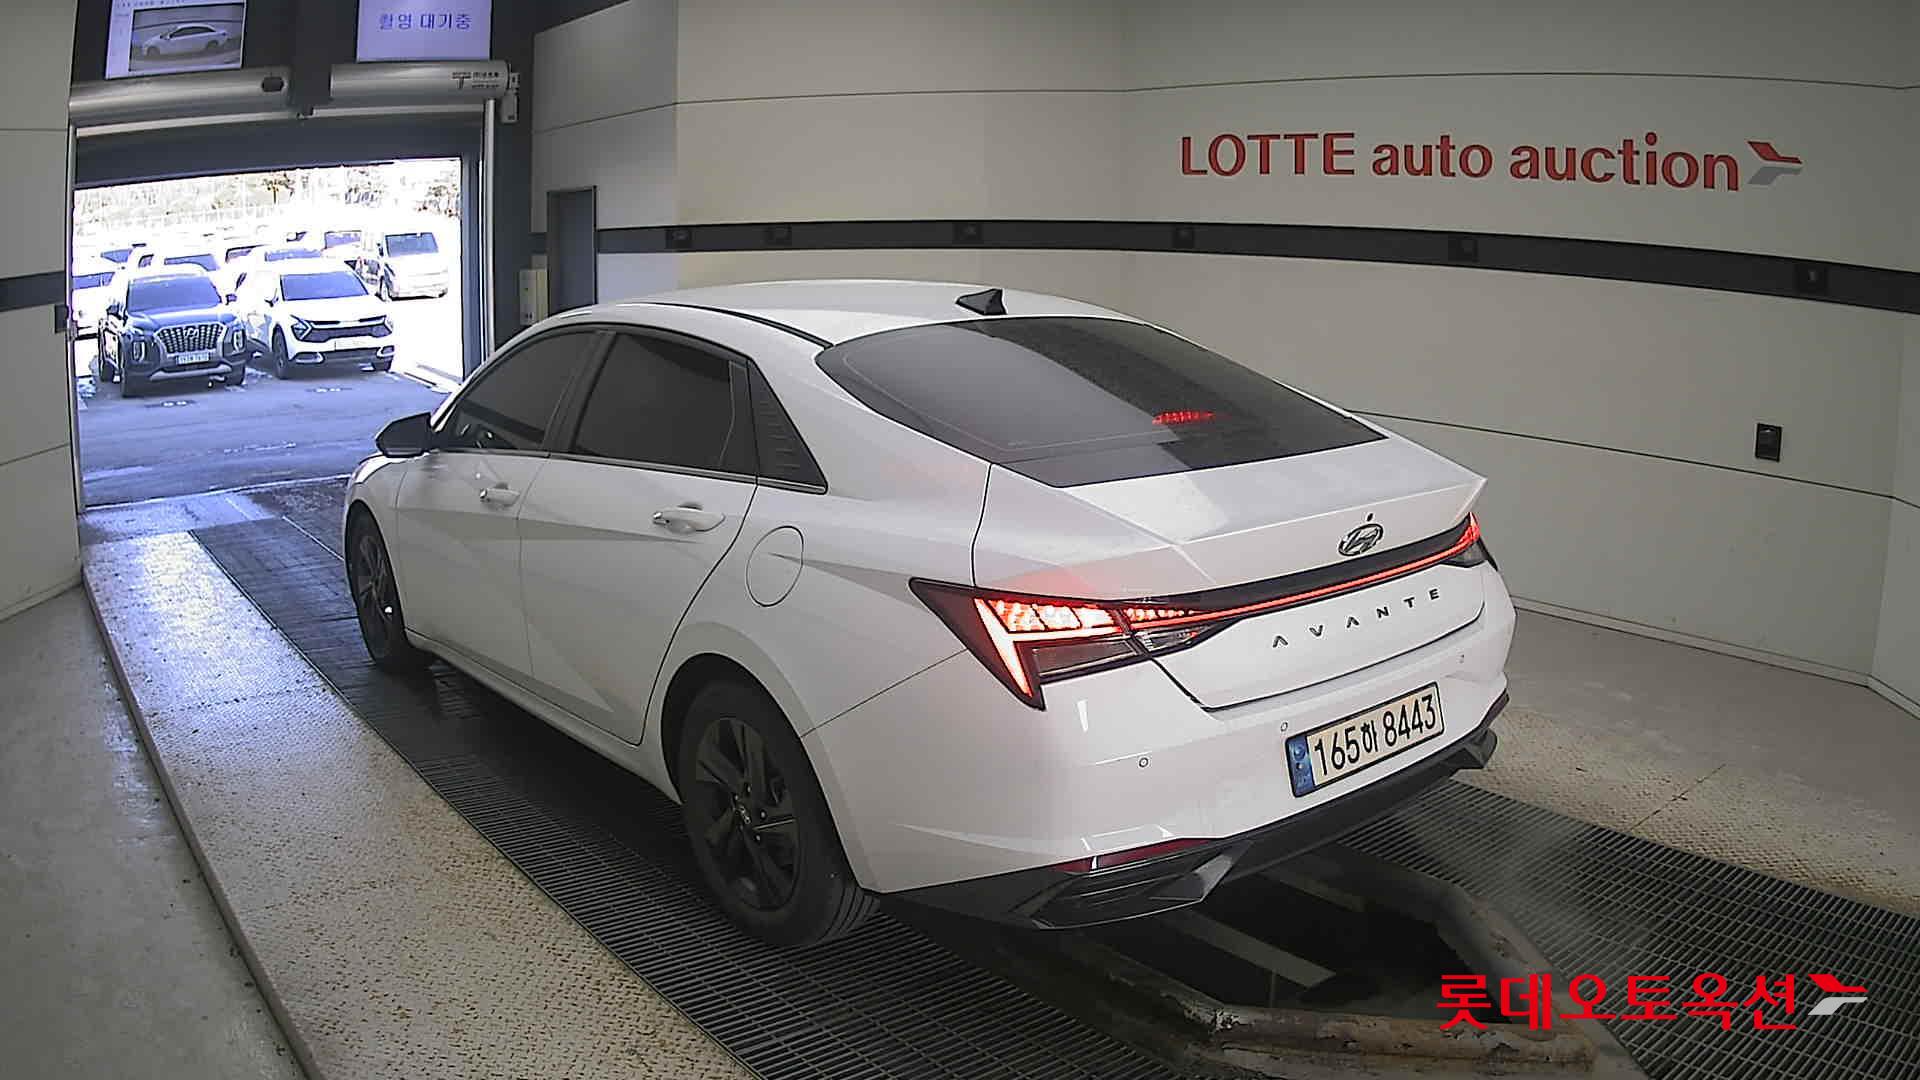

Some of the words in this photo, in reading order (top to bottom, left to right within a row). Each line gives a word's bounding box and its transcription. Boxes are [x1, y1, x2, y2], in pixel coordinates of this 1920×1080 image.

[420, 13, 473, 30] 대기중
[1181, 133, 1355, 176] LOTTE
[1371, 135, 1493, 177] auto
[1509, 132, 1739, 191] auction
[1272, 588, 1441, 648] AVANTE
[1314, 720, 1379, 776] 165하
[1384, 695, 1436, 748] 8443
